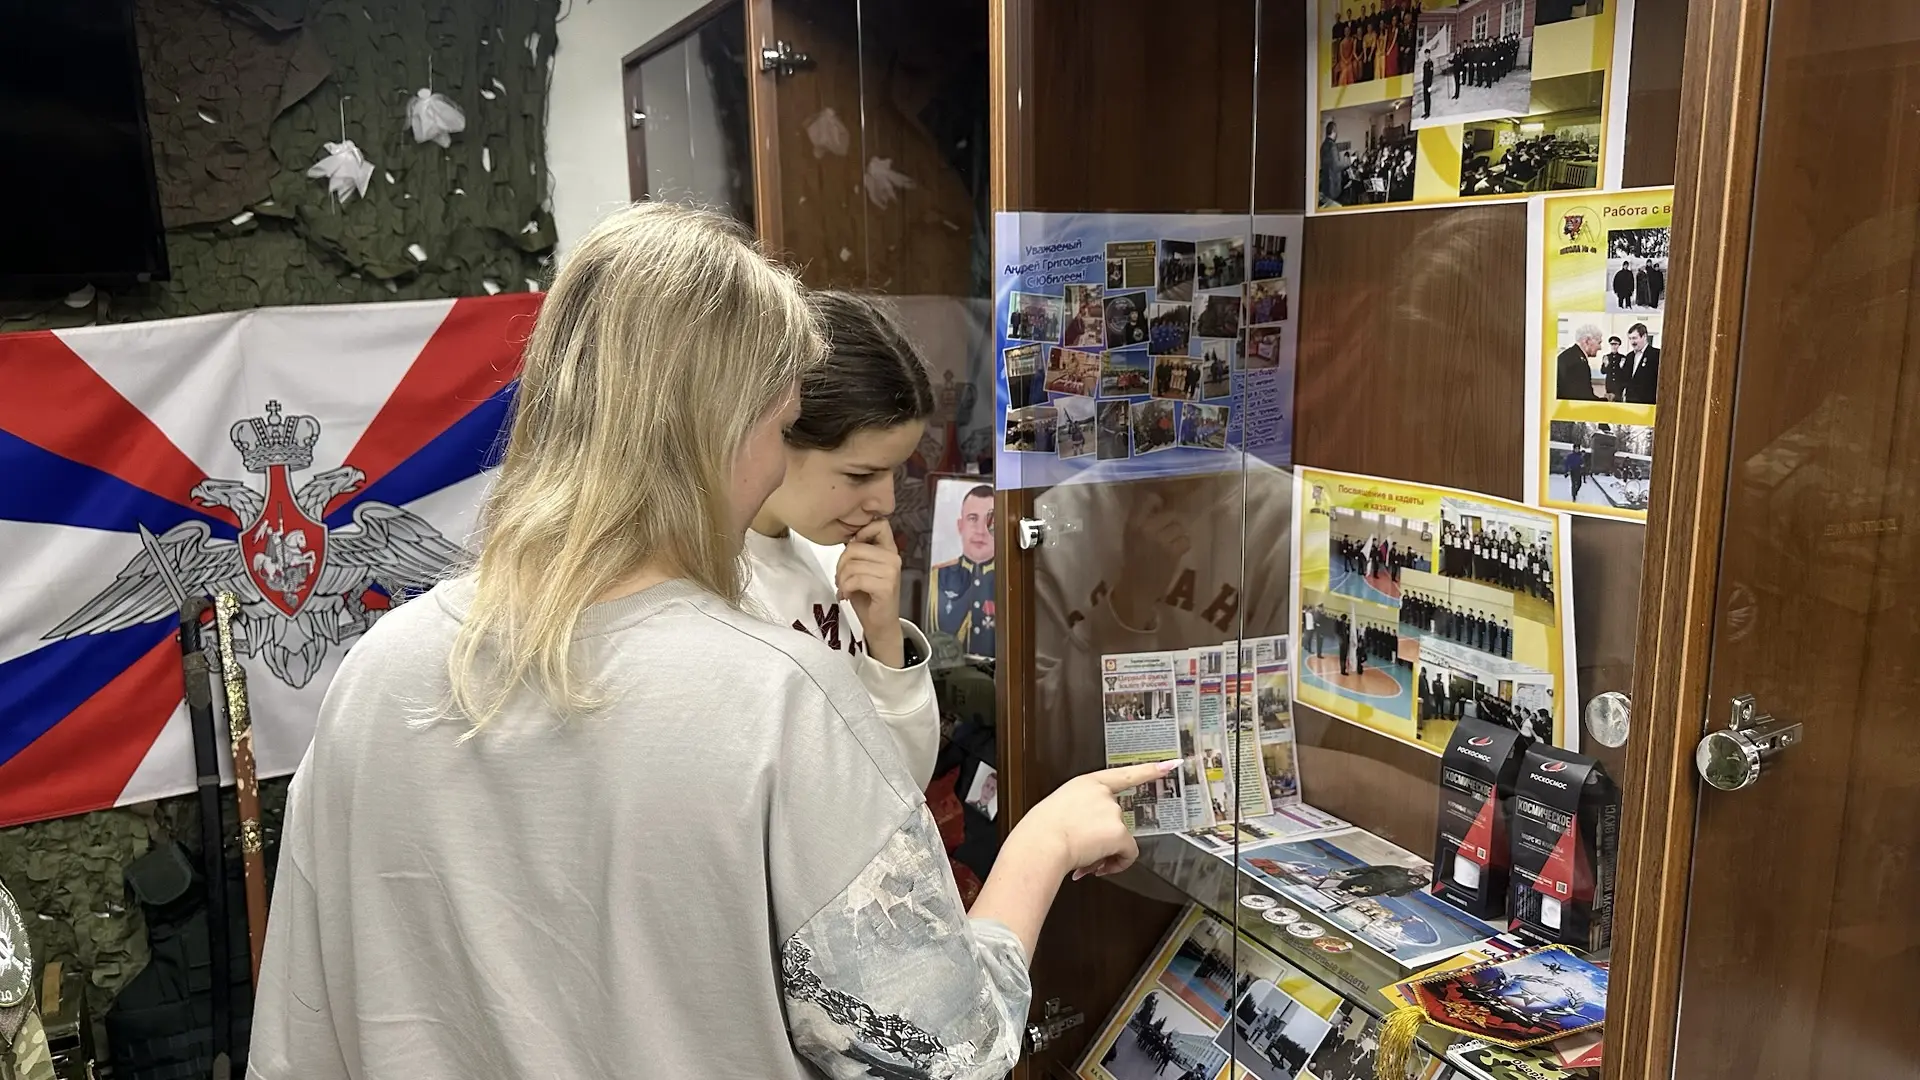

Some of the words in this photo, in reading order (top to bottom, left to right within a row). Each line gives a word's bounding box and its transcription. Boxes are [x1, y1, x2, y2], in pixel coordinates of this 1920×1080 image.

[1603, 205, 1648, 217] Работа
[1652, 206, 1659, 214] с
[1663, 205, 1672, 214] в
[1025, 238, 1083, 256] Уважаемый
[1004, 260, 1041, 275] Андрей
[1042, 251, 1105, 271] Григорьевич!
[1036, 269, 1086, 288] Юбилеем!
[1338, 484, 1387, 500] Посвящение
[1395, 494, 1425, 505] кадеты
[1370, 502, 1397, 513] казаки
[1456, 745, 1492, 763] РОСКОСМОС
[1445, 769, 1493, 798] КОСМИЧЕСКОЕ
[1529, 772, 1568, 790] РОСКОСМОС
[1517, 799, 1572, 828] КОСМИЧЕСКОЕ
[1604, 803, 1617, 834] ВКУС!
